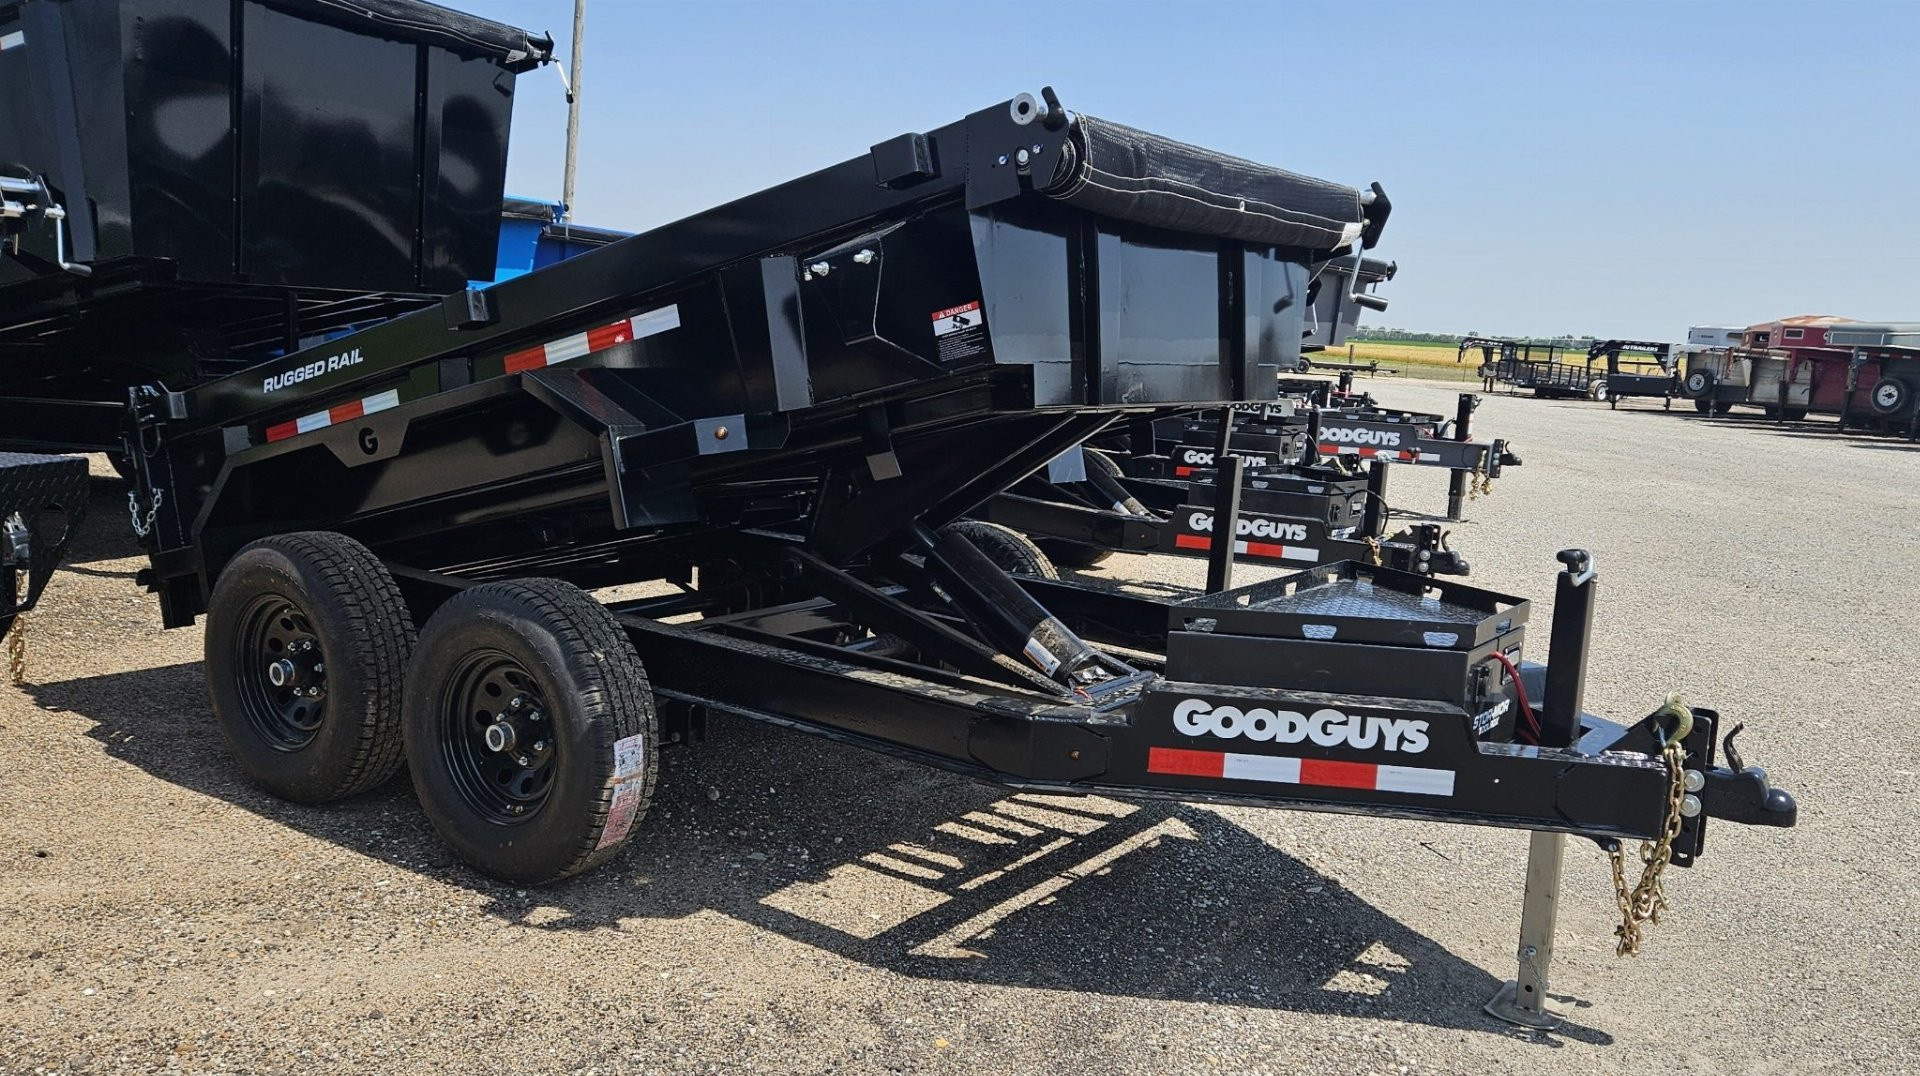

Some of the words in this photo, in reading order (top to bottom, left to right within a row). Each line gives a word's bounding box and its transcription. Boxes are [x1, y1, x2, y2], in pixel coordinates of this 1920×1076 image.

[945, 303, 973, 317] DANGER
[263, 361, 325, 393] RUGGED
[327, 348, 364, 372] RAIL
[358, 427, 378, 455] G
[1319, 426, 1401, 446] OODGUYS
[1173, 698, 1430, 754] GOODGUYS
